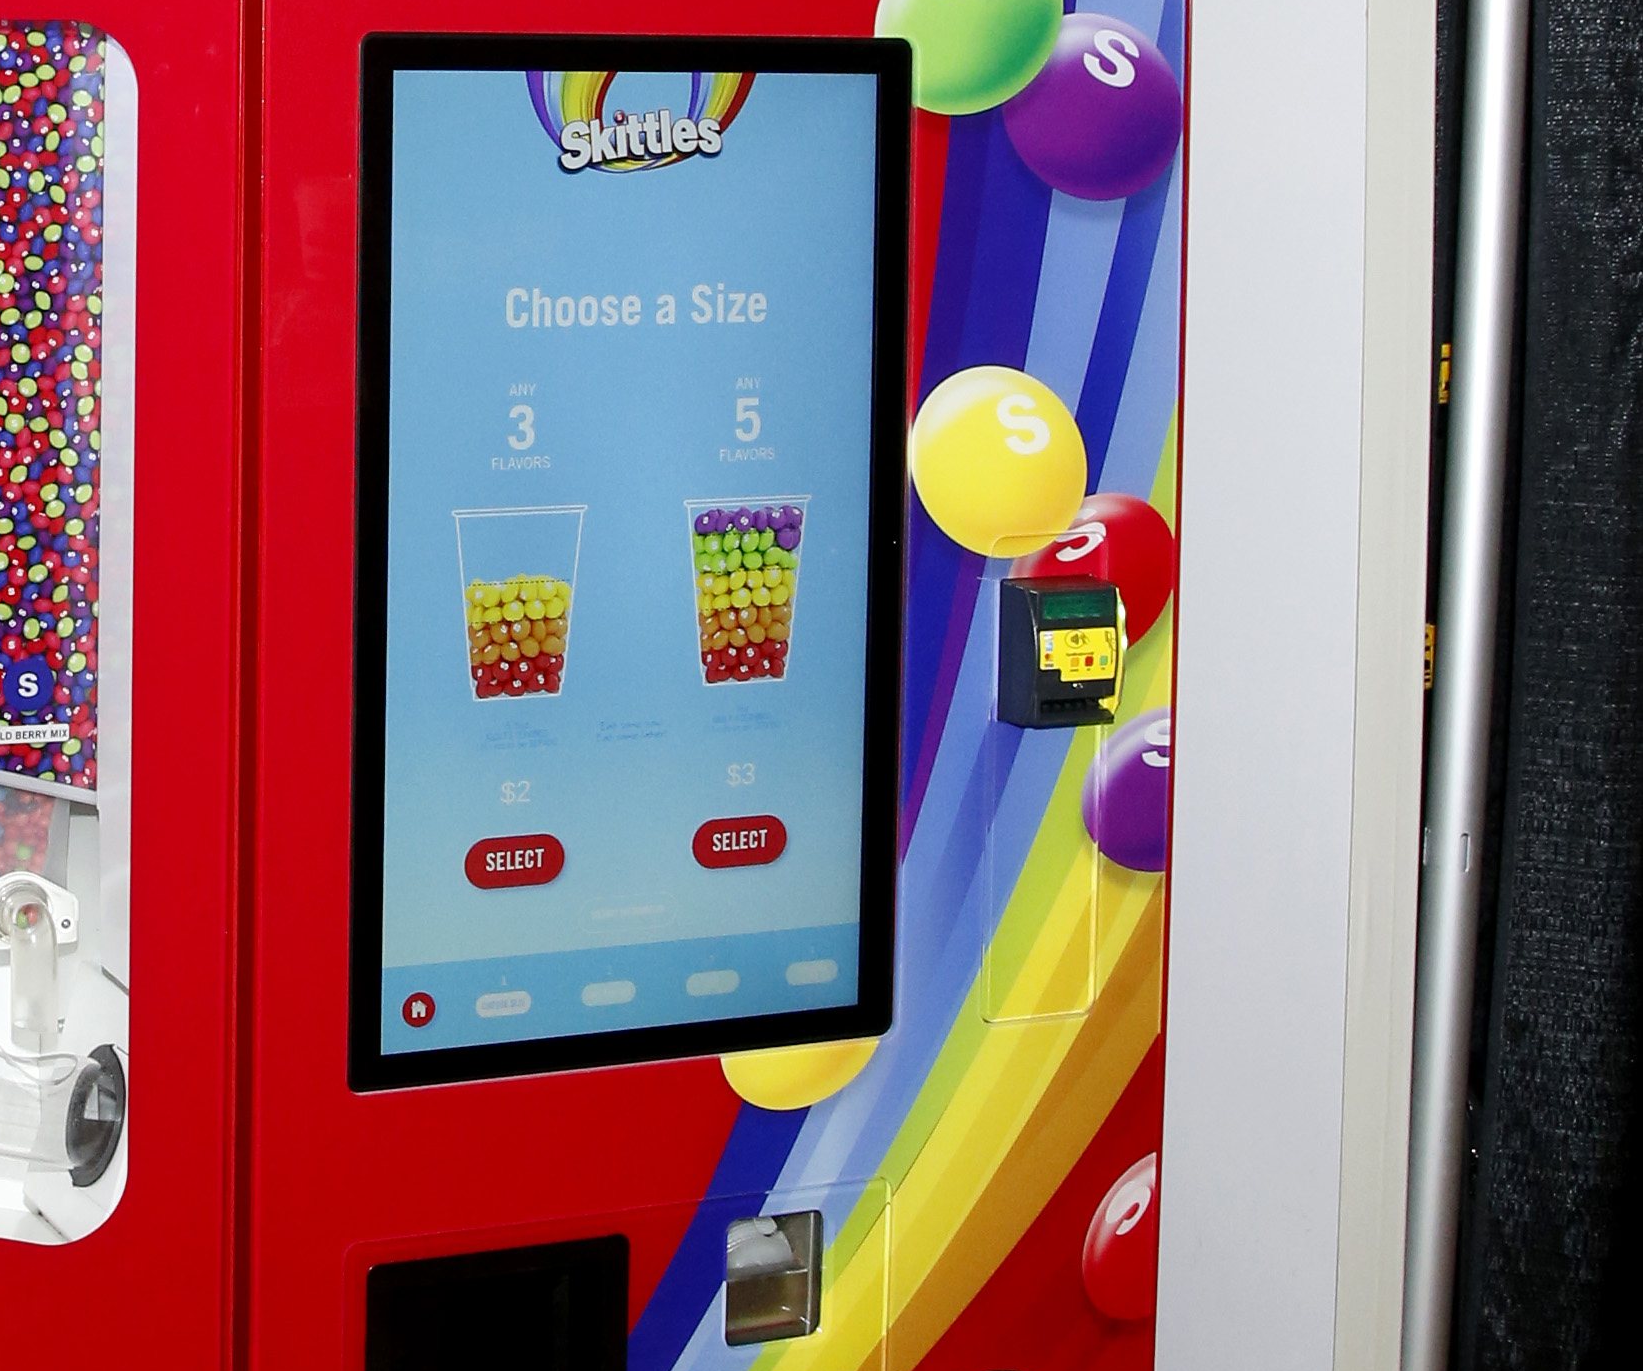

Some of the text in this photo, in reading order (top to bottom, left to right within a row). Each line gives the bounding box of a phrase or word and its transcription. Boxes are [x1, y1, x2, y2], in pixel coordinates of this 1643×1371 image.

[559, 109, 722, 171] Skittles
[505, 284, 767, 328] Choose a Size
[509, 383, 536, 397] ANY
[735, 376, 761, 390] ANY
[507, 404, 535, 450] 3
[735, 397, 761, 442] 5
[491, 456, 551, 470] FLAVORS
[719, 447, 775, 462] FLAVORS
[13, 727, 47, 741] BERRY
[49, 726, 69, 739] MIX
[726, 762, 756, 787] $3
[500, 780, 532, 805] $2
[712, 829, 768, 852] SELECT
[485, 849, 545, 872] SELECT
